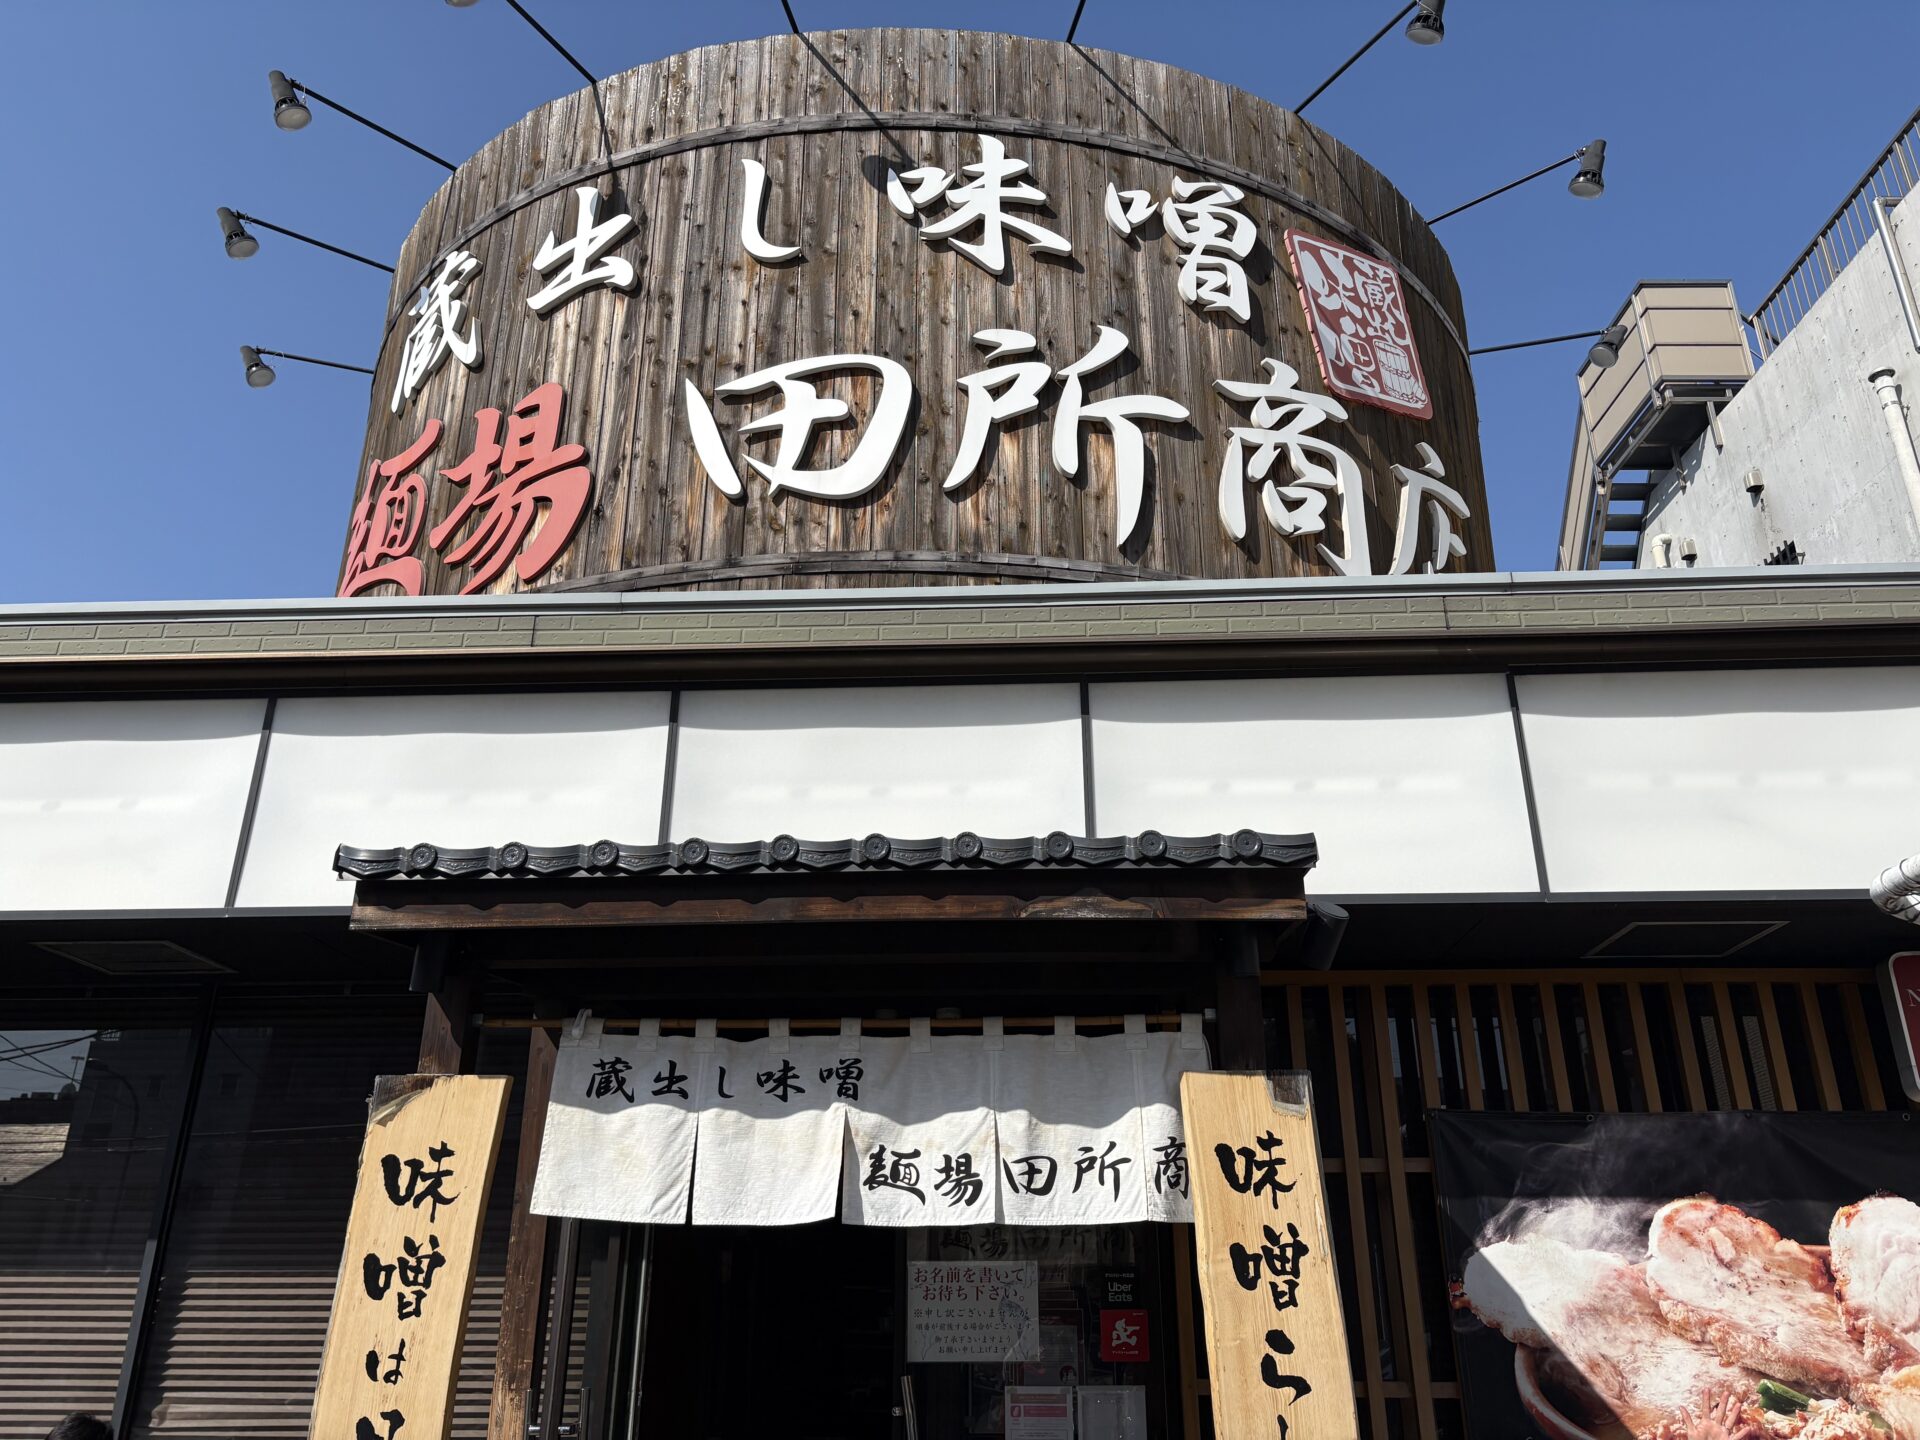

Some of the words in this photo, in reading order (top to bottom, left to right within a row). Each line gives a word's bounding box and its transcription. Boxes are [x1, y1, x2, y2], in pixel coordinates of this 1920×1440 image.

[392, 134, 1258, 415] 蔵出し味噌
[586, 1058, 864, 1102] 蔵出し味噌
[914, 1267, 1025, 1284] お名前を書いて
[922, 1285, 1025, 1302] お待ち下さい。
[1108, 1282, 1133, 1292] Uber
[1108, 1292, 1133, 1302] Eats
